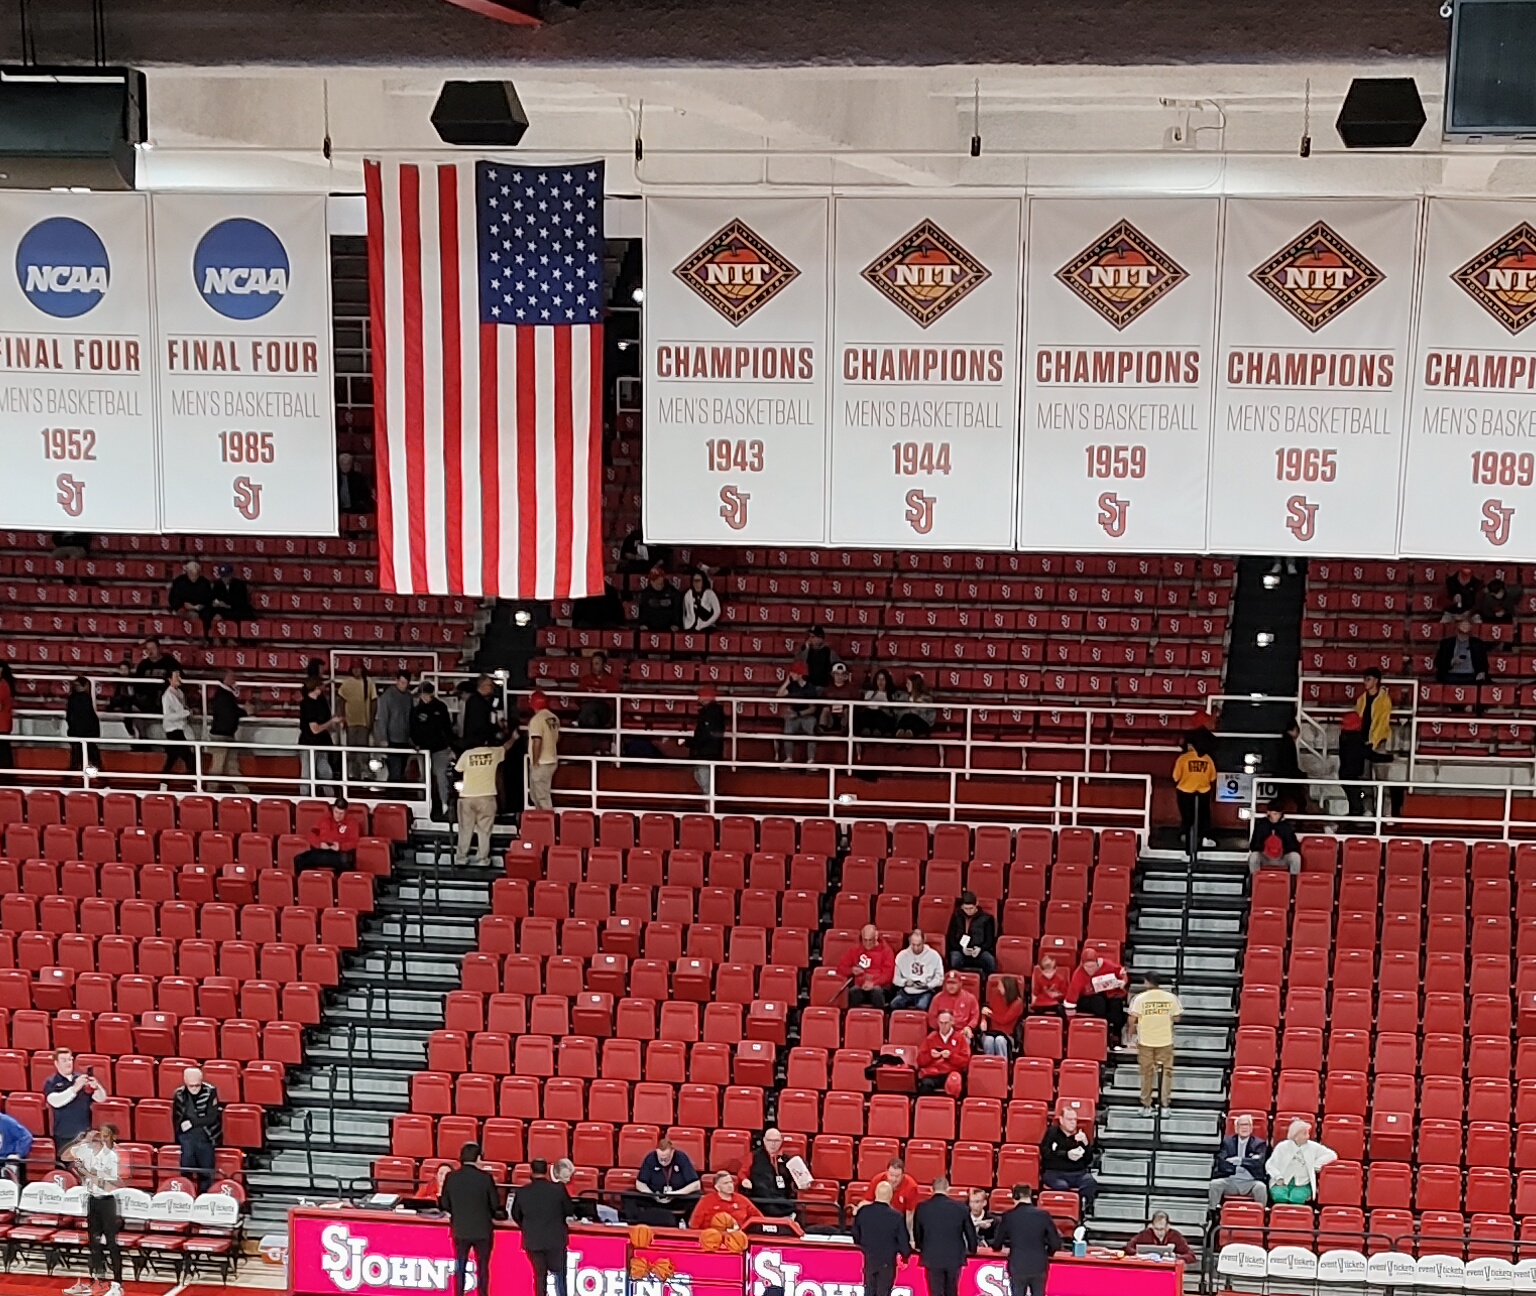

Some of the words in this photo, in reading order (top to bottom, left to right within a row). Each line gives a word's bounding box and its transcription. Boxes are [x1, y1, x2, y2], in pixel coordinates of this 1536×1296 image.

[1322, 231, 1371, 275] INVITATION
[25, 265, 110, 295] NCAA
[203, 267, 289, 296] NCAA
[704, 262, 771, 286] NIT
[893, 265, 962, 288] NIT
[1089, 265, 1158, 289] NIT
[1284, 267, 1354, 290] NIT
[74, 338, 140, 372] FOUR
[167, 338, 240, 372] FINAL
[252, 340, 318, 374] FOUR
[656, 346, 814, 380] CHAMPIONS
[843, 348, 1003, 383] CHAMPIONS
[1036, 351, 1200, 384] CHAMPIONS
[1227, 351, 1394, 387] CHAMPIONS
[47, 389, 142, 418] BASKETBALL
[171, 389, 222, 418] MEN'S
[224, 390, 321, 419] BASKETBALL
[659, 397, 710, 425] MEN'S
[713, 398, 814, 426] BASKETBALL
[845, 400, 896, 428] MEN'S
[899, 401, 1003, 430] BASKETBALL
[1036, 403, 1089, 431] MEN'S
[1094, 404, 1199, 432] BASKETBALL
[1226, 404, 1281, 433] MEN'S
[1285, 405, 1391, 435] BASKETBALL
[1422, 406, 1477, 436] MEN'S
[41, 428, 97, 462] 1952
[217, 431, 275, 465] 1985
[706, 438, 765, 473] 1943
[892, 442, 952, 475] 1944
[1085, 444, 1146, 479] 1959
[1275, 447, 1337, 482] 1965
[1470, 451, 1535, 487] 1989
[1227, 780, 1239, 794] 9
